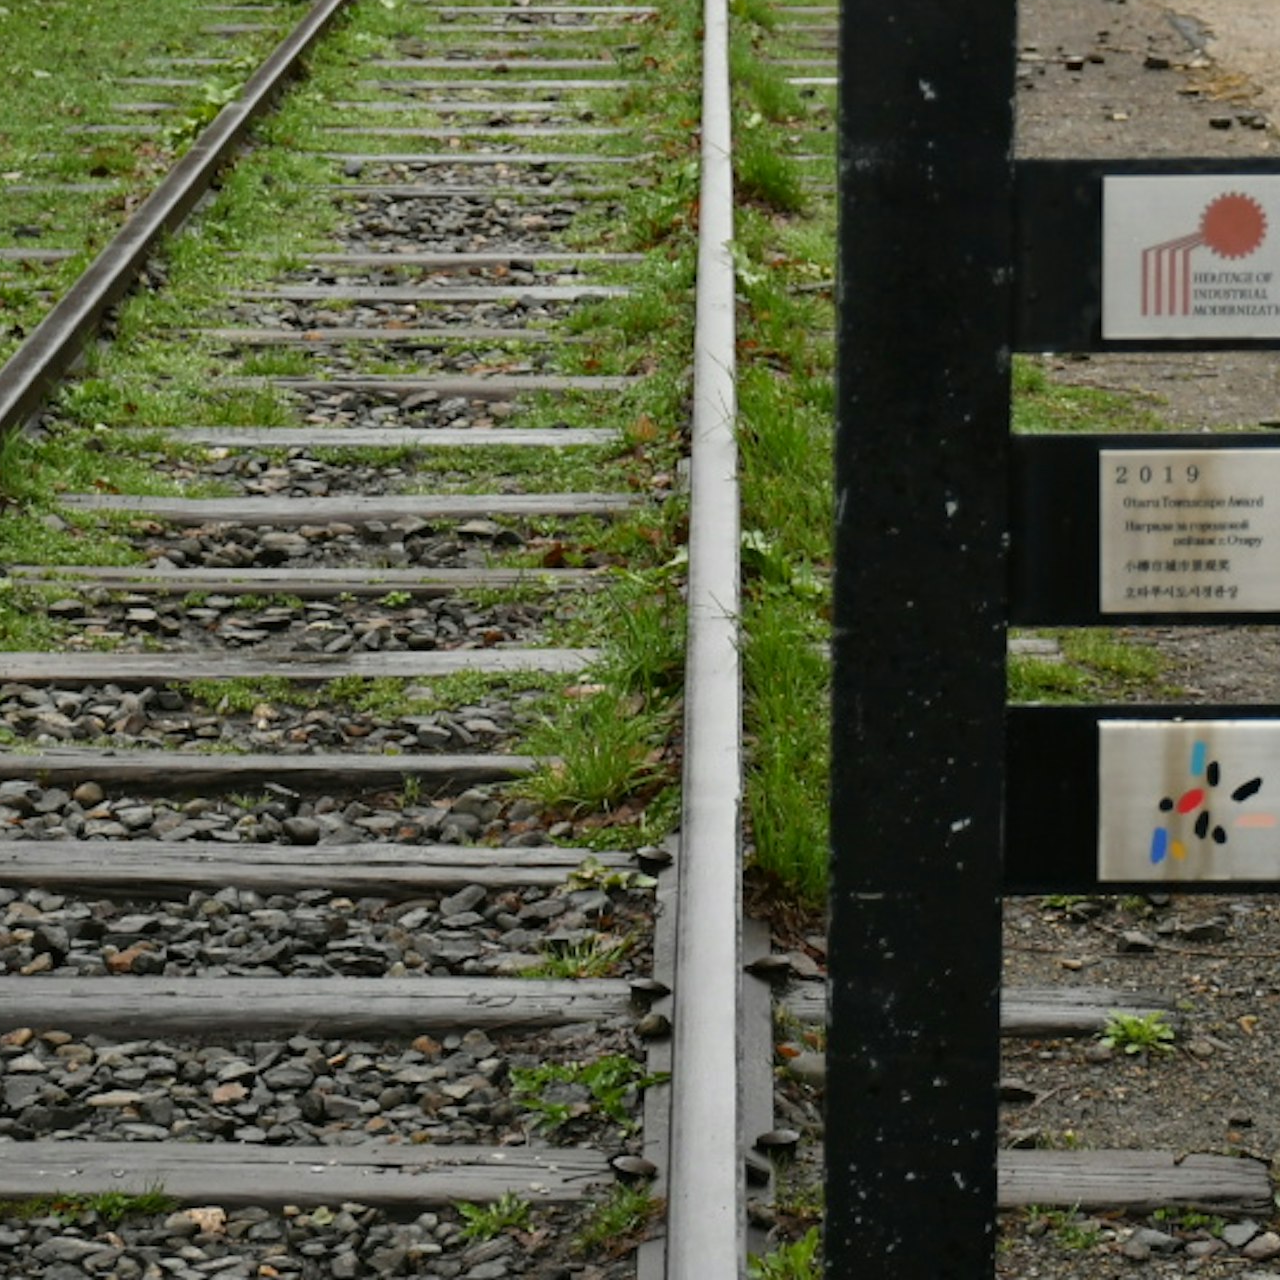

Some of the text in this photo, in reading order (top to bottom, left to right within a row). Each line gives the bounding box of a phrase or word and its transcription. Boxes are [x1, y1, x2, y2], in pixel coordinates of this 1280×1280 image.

[1193, 272, 1272, 284] HERITAGE OF
[1193, 288, 1268, 300] INDUSTRIAL
[1115, 464, 1201, 485] 2019
[1122, 494, 1263, 511] Otaru Townscape Award
